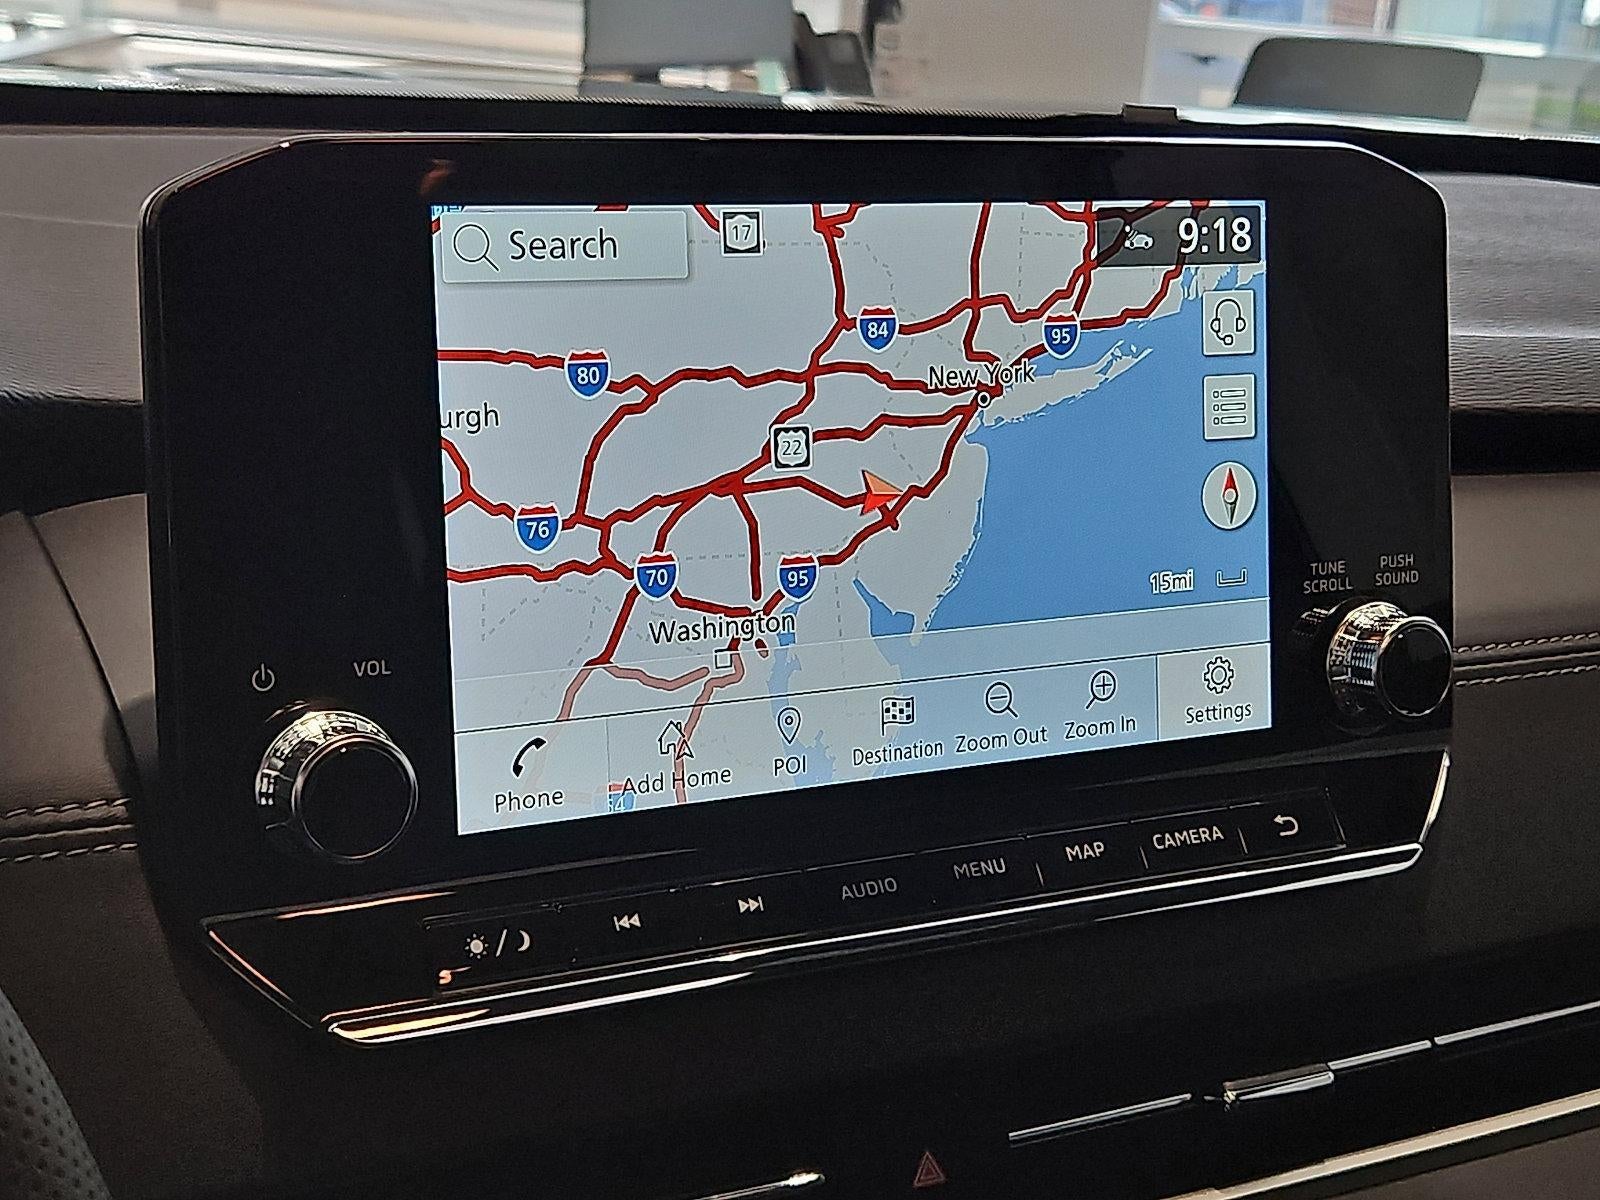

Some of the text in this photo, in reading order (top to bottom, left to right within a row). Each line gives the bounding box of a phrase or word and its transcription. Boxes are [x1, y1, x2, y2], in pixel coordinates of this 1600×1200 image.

[732, 223, 751, 243] 17
[1177, 216, 1253, 255] 9:18
[509, 229, 619, 262] Search
[867, 320, 889, 340] 84
[1050, 325, 1072, 345] 95
[576, 366, 600, 386] 80
[929, 360, 1036, 389] New York
[781, 437, 803, 456] 22
[525, 520, 550, 541] 76
[1310, 561, 1346, 576] TUNE
[1380, 553, 1414, 569] PUSH
[644, 567, 669, 588] 70
[787, 570, 810, 588] 95
[1150, 570, 1194, 595] 15mi
[1303, 577, 1353, 594] SCROLL
[1375, 570, 1419, 586] SOUND
[649, 611, 796, 646] Washington
[353, 659, 392, 677] VOL
[1185, 701, 1253, 726] Settings
[1064, 714, 1137, 741] Zoom In
[955, 727, 1048, 754] Zoom Out
[852, 738, 944, 767] Destination
[773, 754, 807, 777] POI
[622, 765, 732, 796] Add Home
[494, 788, 565, 814] Phone
[1152, 825, 1224, 851] CAMERA
[1065, 842, 1105, 863] MAP
[953, 857, 1007, 881] MENU
[840, 876, 898, 902] AUDIO
